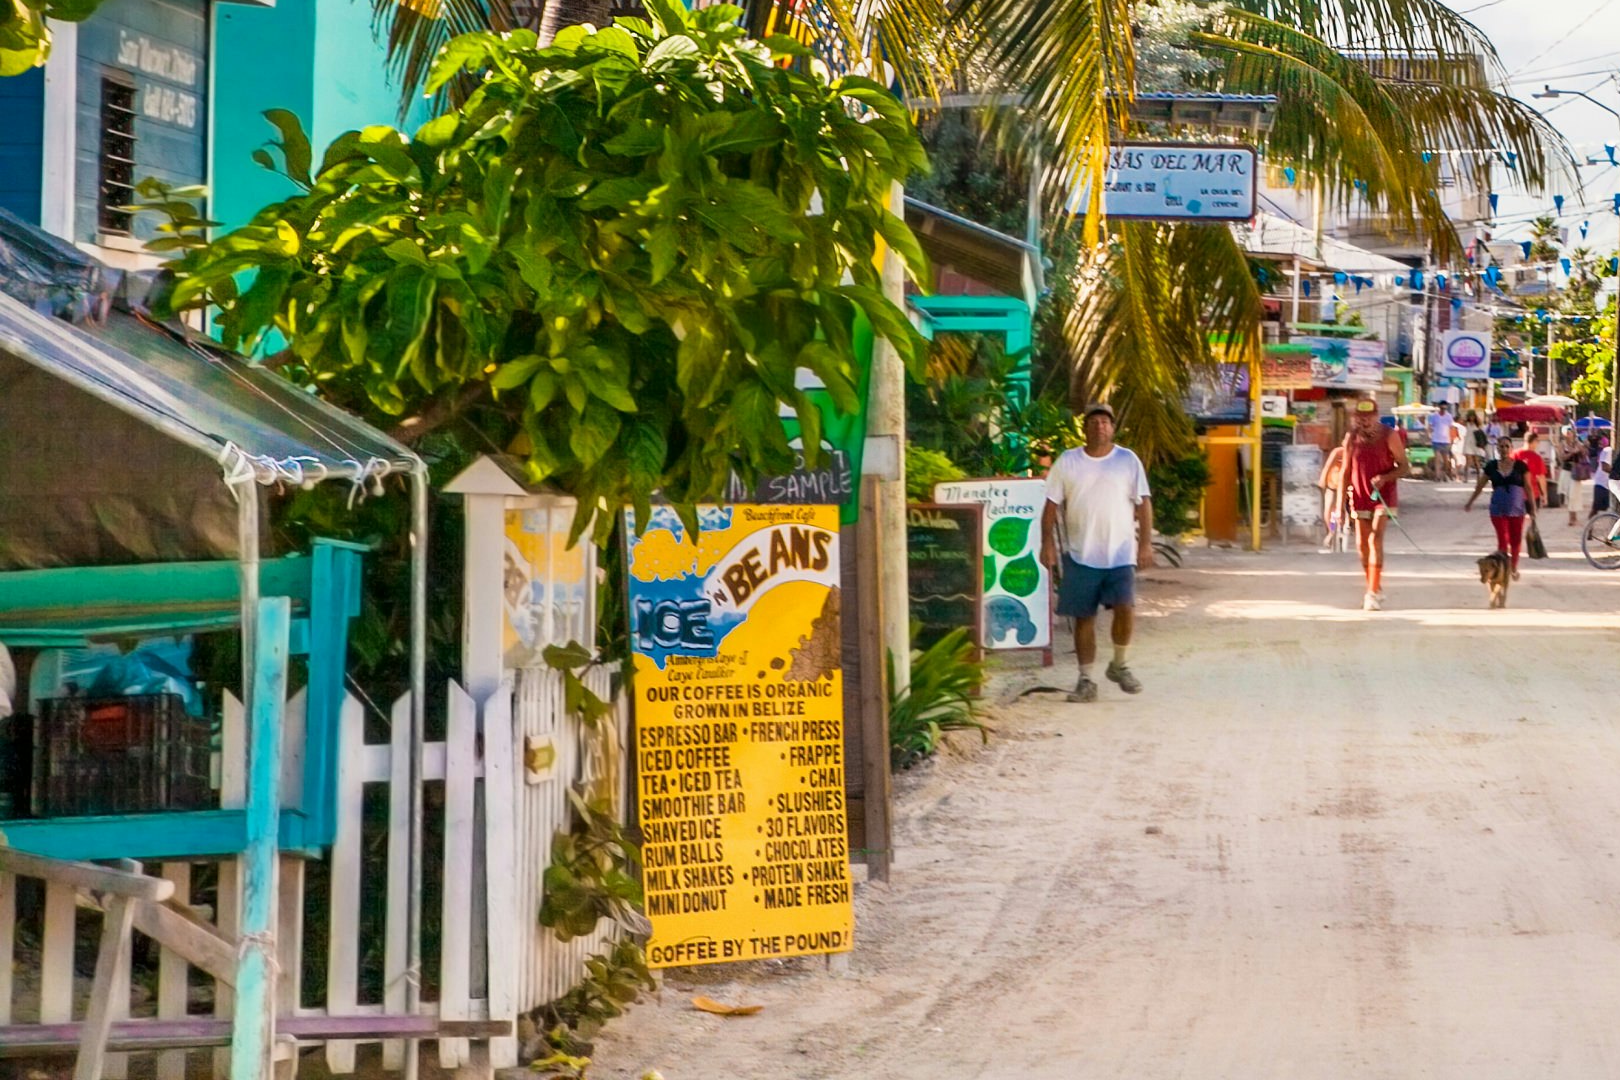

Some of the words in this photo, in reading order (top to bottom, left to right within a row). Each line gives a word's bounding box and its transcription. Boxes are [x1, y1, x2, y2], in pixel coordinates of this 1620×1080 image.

[1151, 152, 1186, 170] DEL
[1192, 153, 1245, 175] MAR
[769, 471, 853, 501] SAMPLE
[942, 484, 1009, 500] Manatee
[722, 526, 832, 608] BEANS
[637, 598, 715, 649] ICE
[647, 687, 679, 702] OUR
[684, 685, 743, 700] COFFEE
[747, 684, 761, 698] IS
[765, 683, 833, 698] ORGANIC
[674, 704, 730, 719] GROWN
[734, 703, 749, 717] IN
[753, 701, 806, 717] BELIZE
[639, 724, 710, 748] ESPRESSO
[713, 722, 738, 743] BAR
[750, 721, 800, 742] FRENCH
[802, 720, 840, 741] PRESS
[640, 750, 672, 772] ICED
[675, 746, 731, 769] COFFEE
[789, 744, 841, 767] FRAPPE
[641, 774, 669, 795] TEA
[679, 771, 711, 792] ICED
[714, 768, 743, 790] TEA
[809, 767, 842, 788] CHAI
[642, 794, 714, 821] SMOOTHIE
[718, 791, 746, 814] BAR
[777, 790, 842, 813] SLUSHIES
[643, 820, 697, 844] SHAVED
[700, 817, 722, 839] ICE
[765, 817, 783, 838] 30
[786, 814, 845, 837] FLAVORS
[644, 846, 677, 868] RUM
[681, 842, 724, 865] BALLS
[765, 837, 845, 863] CHOCOLATES
[647, 868, 681, 891] MILK
[683, 865, 734, 889] SHAKES
[752, 863, 803, 887] PROTEIN
[806, 860, 846, 883] SHAKE
[648, 893, 681, 917] MINI
[682, 889, 727, 914] DONUT
[764, 886, 803, 909] MADE
[806, 883, 849, 905] FRESH
[651, 940, 718, 964] COFFEE
[723, 938, 744, 958] BY
[750, 935, 781, 955] THE
[785, 930, 848, 952] POUND!
